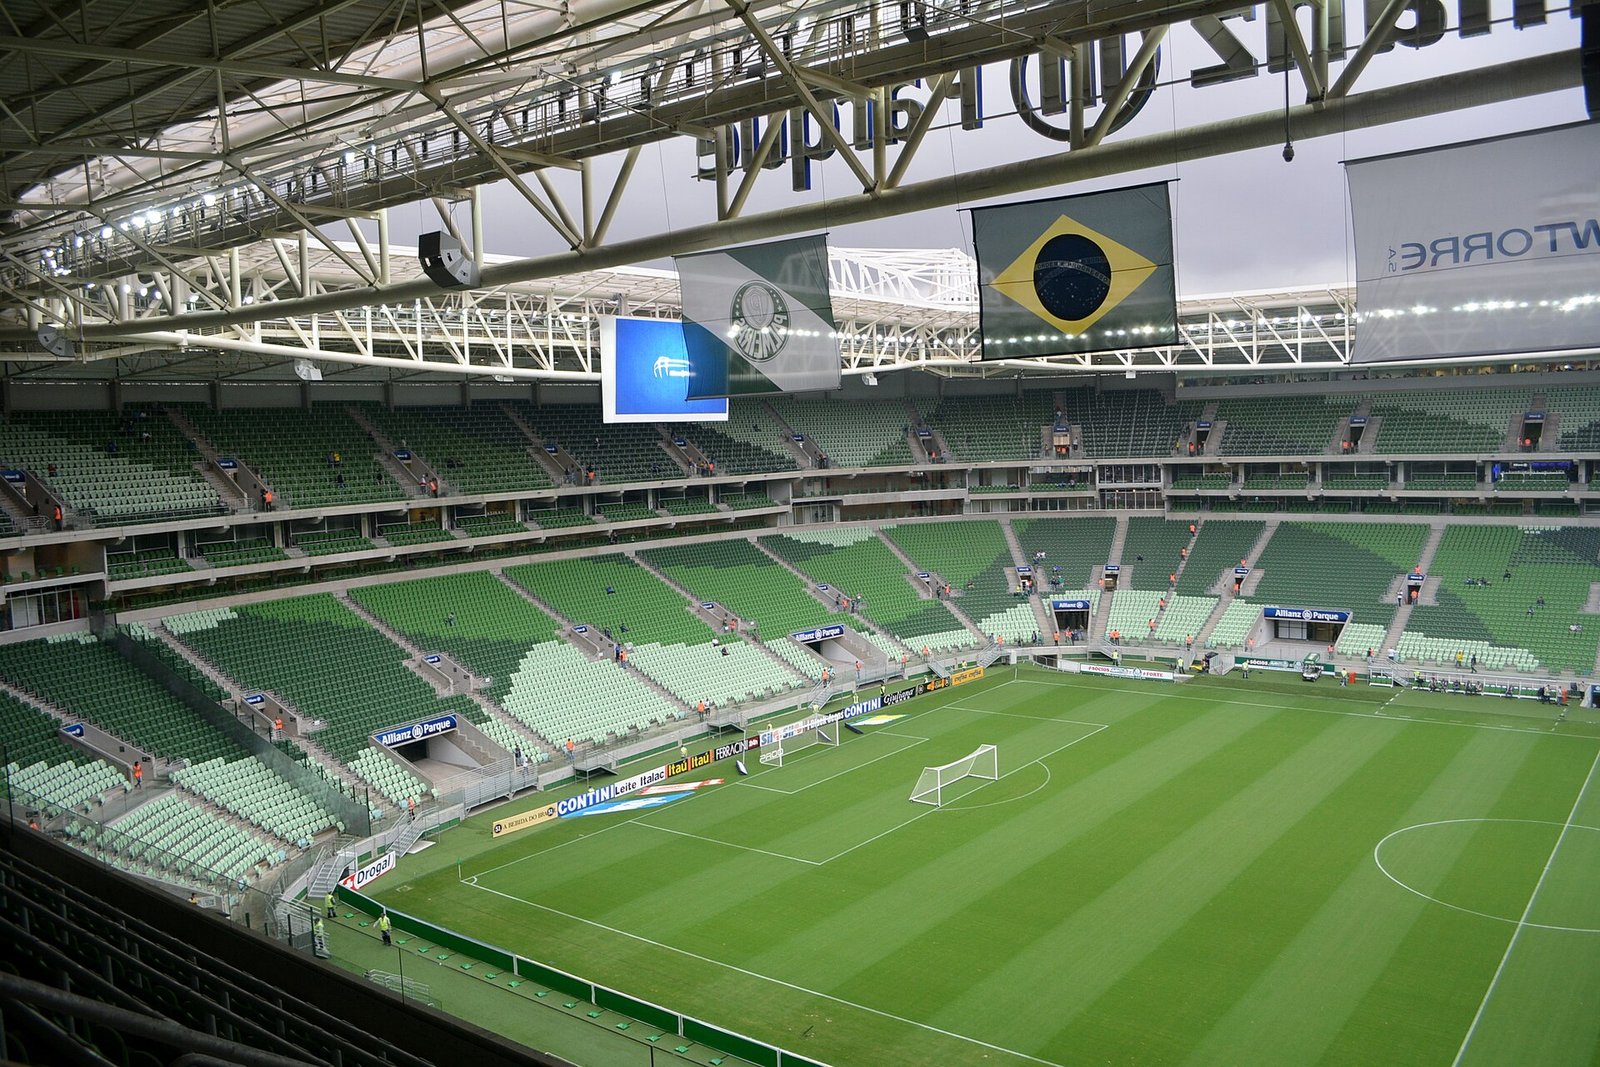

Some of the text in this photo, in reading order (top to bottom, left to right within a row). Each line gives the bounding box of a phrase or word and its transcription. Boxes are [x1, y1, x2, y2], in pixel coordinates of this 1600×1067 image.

[1274, 609, 1339, 621] Allianz Parque
[844, 697, 881, 718] CONTINI
[382, 720, 451, 745] Allianz Parque
[761, 732, 773, 745] Sil
[668, 760, 687, 776] Itaú
[692, 751, 710, 768] Itaú
[615, 771, 664, 795] Leite Italac
[558, 785, 614, 815] CONTINI
[357, 854, 391, 884] Drogal
